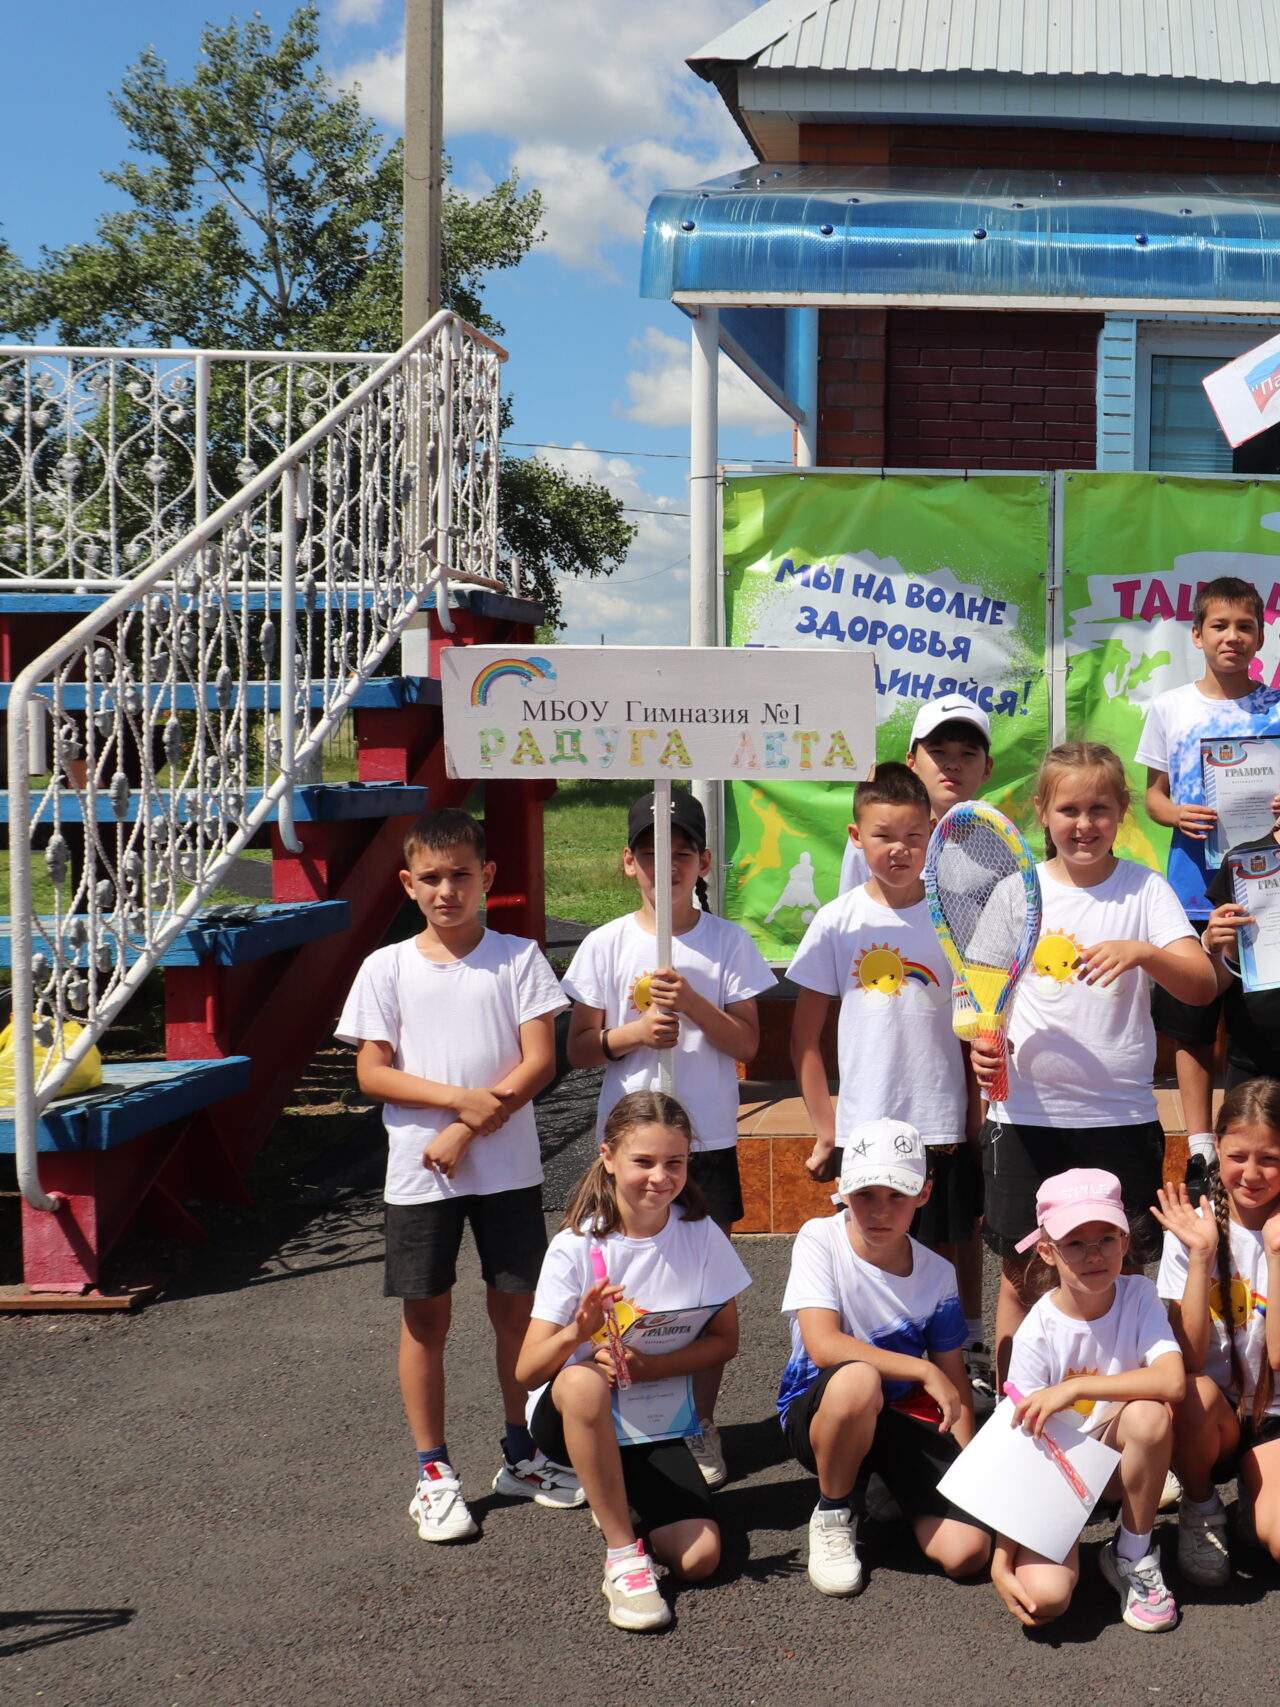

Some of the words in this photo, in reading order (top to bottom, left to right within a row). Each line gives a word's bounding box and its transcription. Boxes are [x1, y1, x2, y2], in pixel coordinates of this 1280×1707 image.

[774, 558, 845, 594] МЫ
[852, 573, 896, 605] НА
[905, 583, 1007, 625] ВОЛНЕ
[795, 606, 972, 663] ЗДОРОВЬЯ
[521, 699, 608, 724] МБОУ
[625, 700, 749, 725] Гимназия
[760, 702, 803, 725] №1
[476, 726, 694, 770] РАДУГА
[729, 729, 857, 770] ЛЕТА
[1224, 766, 1276, 778] ГРАМОТА
[1062, 1184, 1110, 1200] STYLE
[640, 1323, 692, 1338] ГРАМОТА
